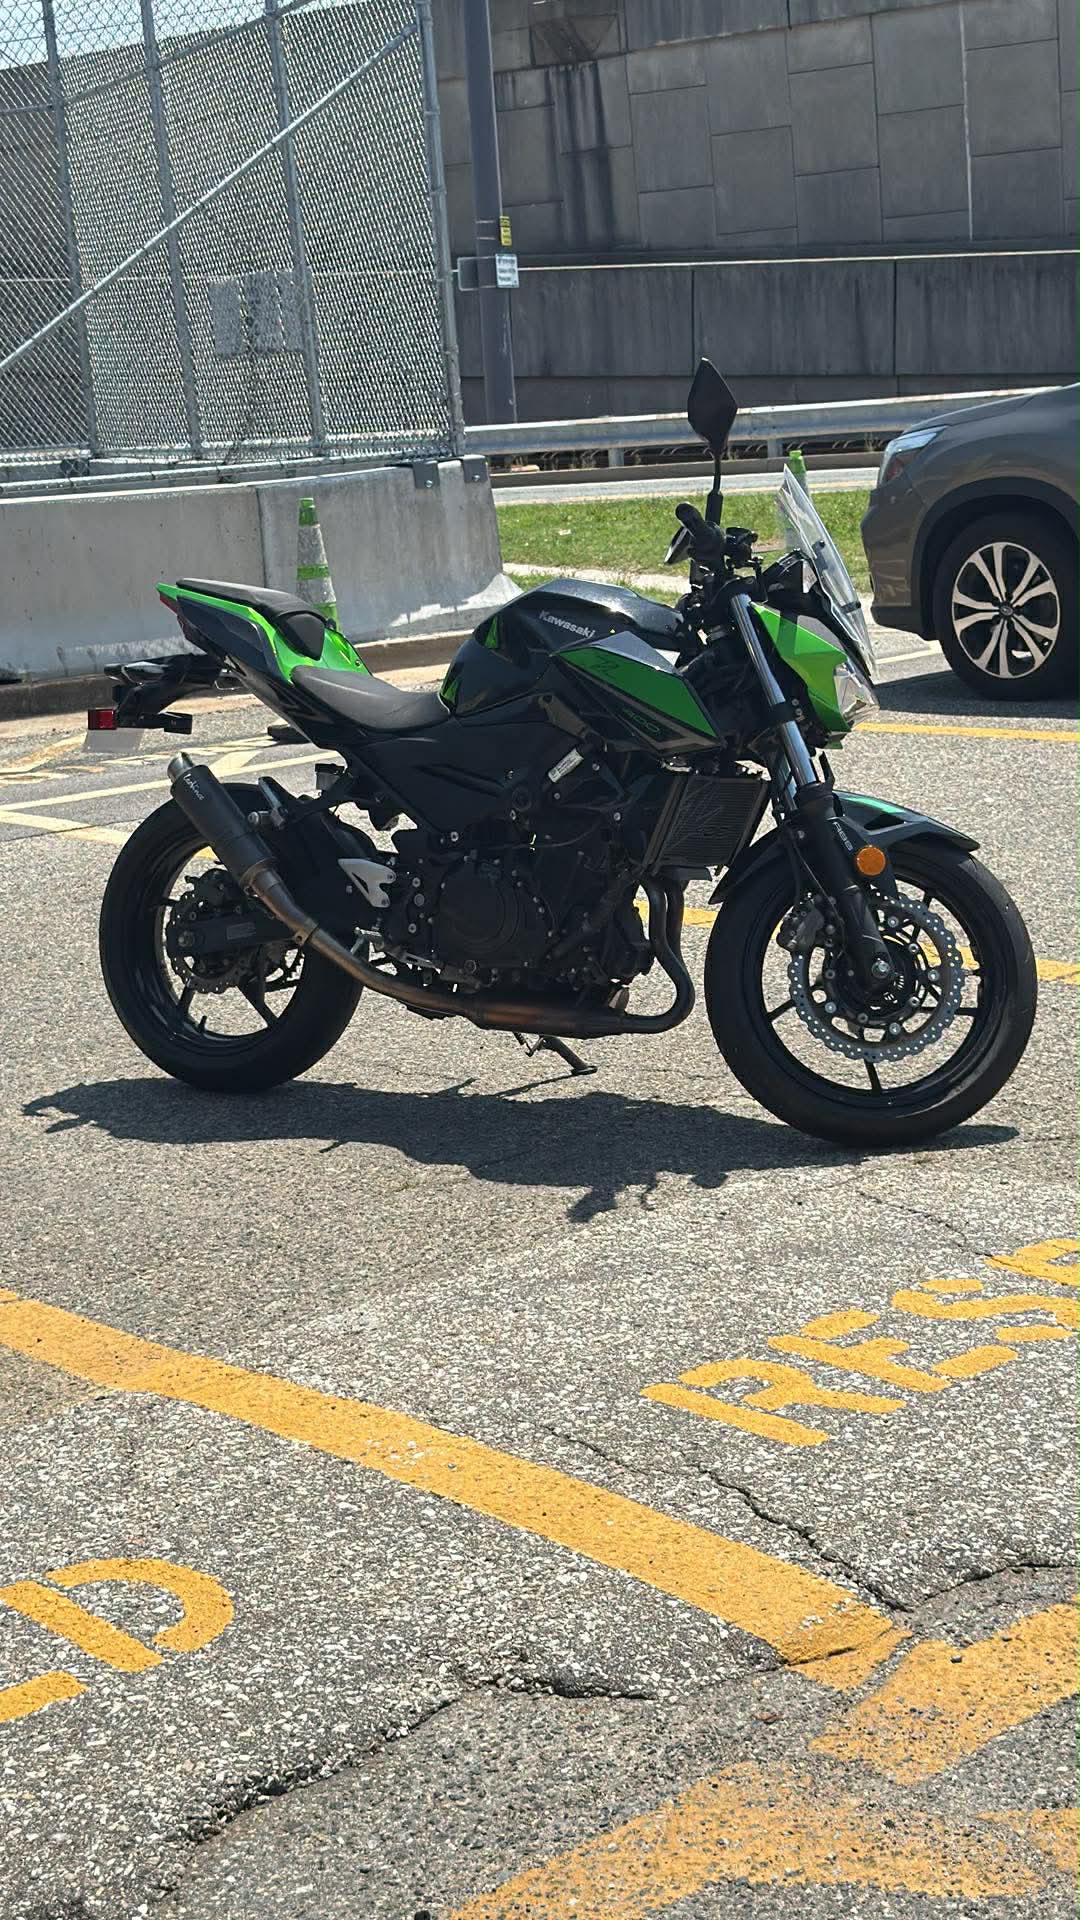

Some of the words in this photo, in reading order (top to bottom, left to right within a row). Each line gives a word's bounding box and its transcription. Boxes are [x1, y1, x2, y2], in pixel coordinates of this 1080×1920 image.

[538, 610, 596, 640] Kawasaki
[832, 821, 854, 851] ABS
[0, 1558, 234, 1722] D
